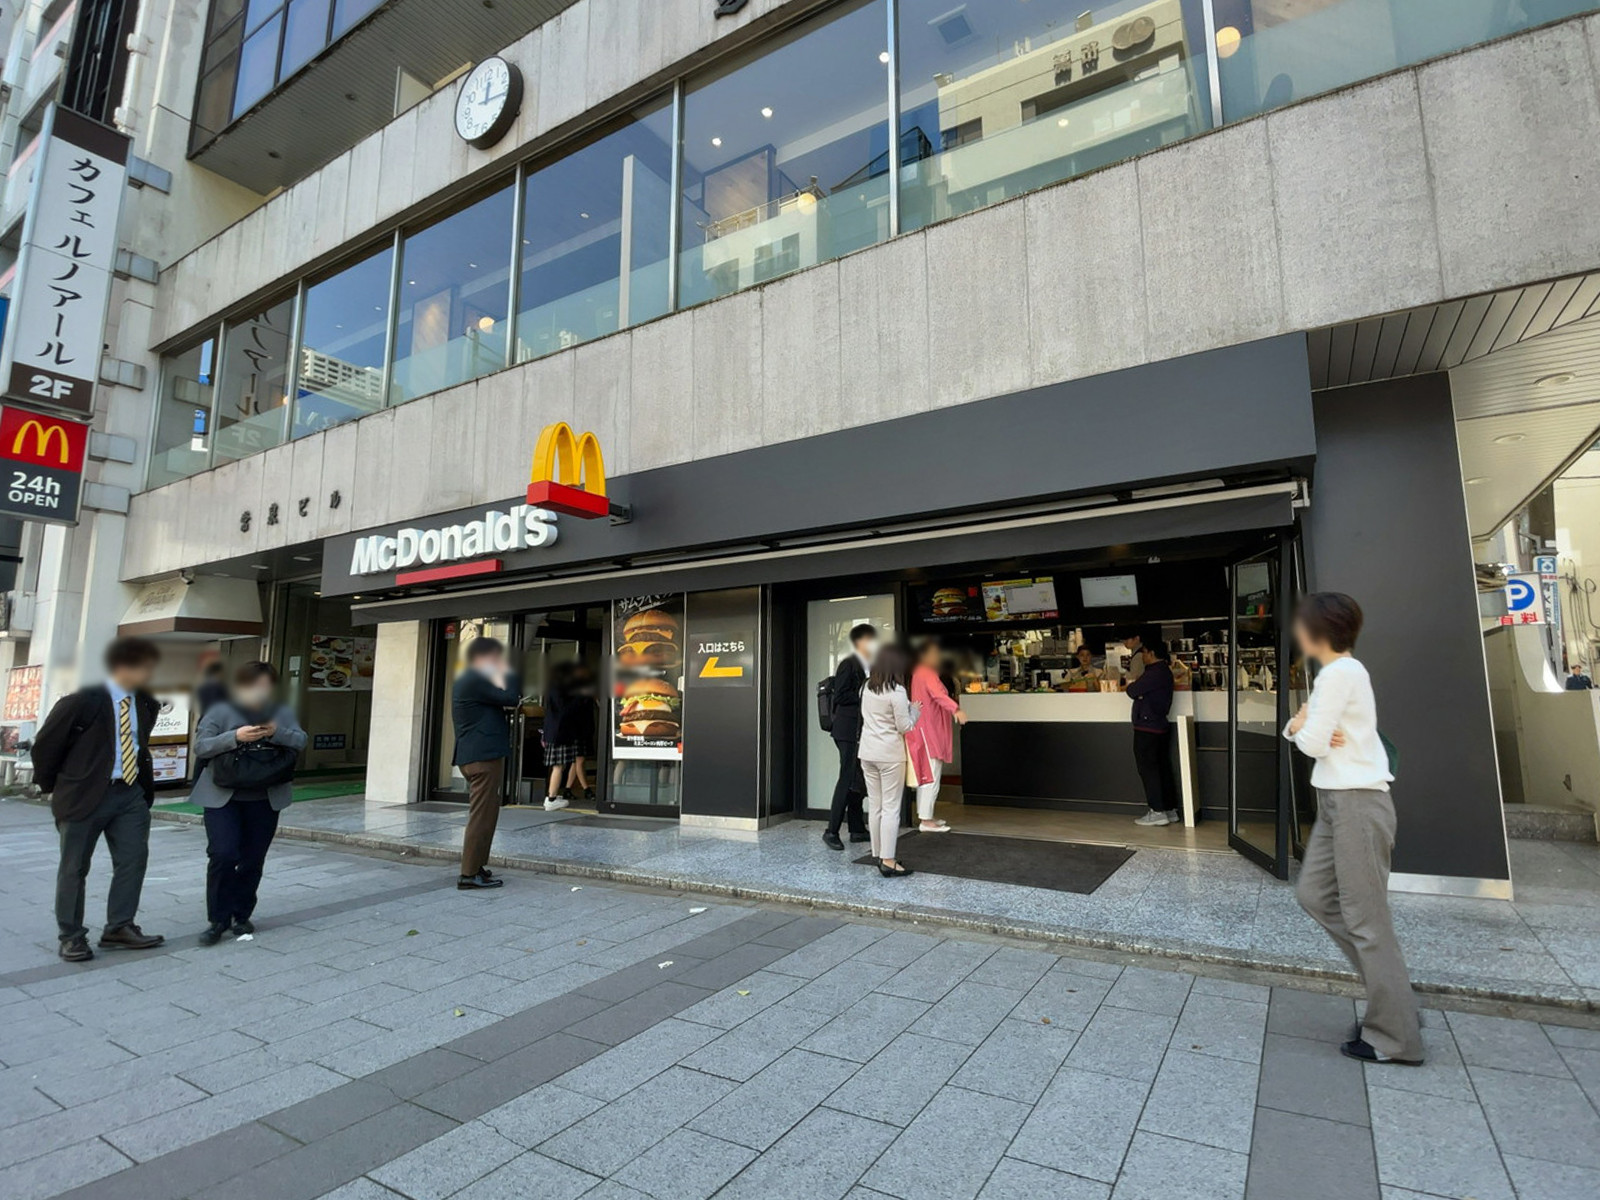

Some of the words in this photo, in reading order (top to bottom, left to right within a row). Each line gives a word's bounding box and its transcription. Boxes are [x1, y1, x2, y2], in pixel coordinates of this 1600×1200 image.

[35, 157, 102, 366] カフェルノアール
[29, 374, 75, 399] 2F
[9, 471, 61, 495] 24h
[8, 490, 60, 509] OPEN
[350, 504, 559, 576] McDonald's
[697, 641, 746, 654] 入口はこちら
